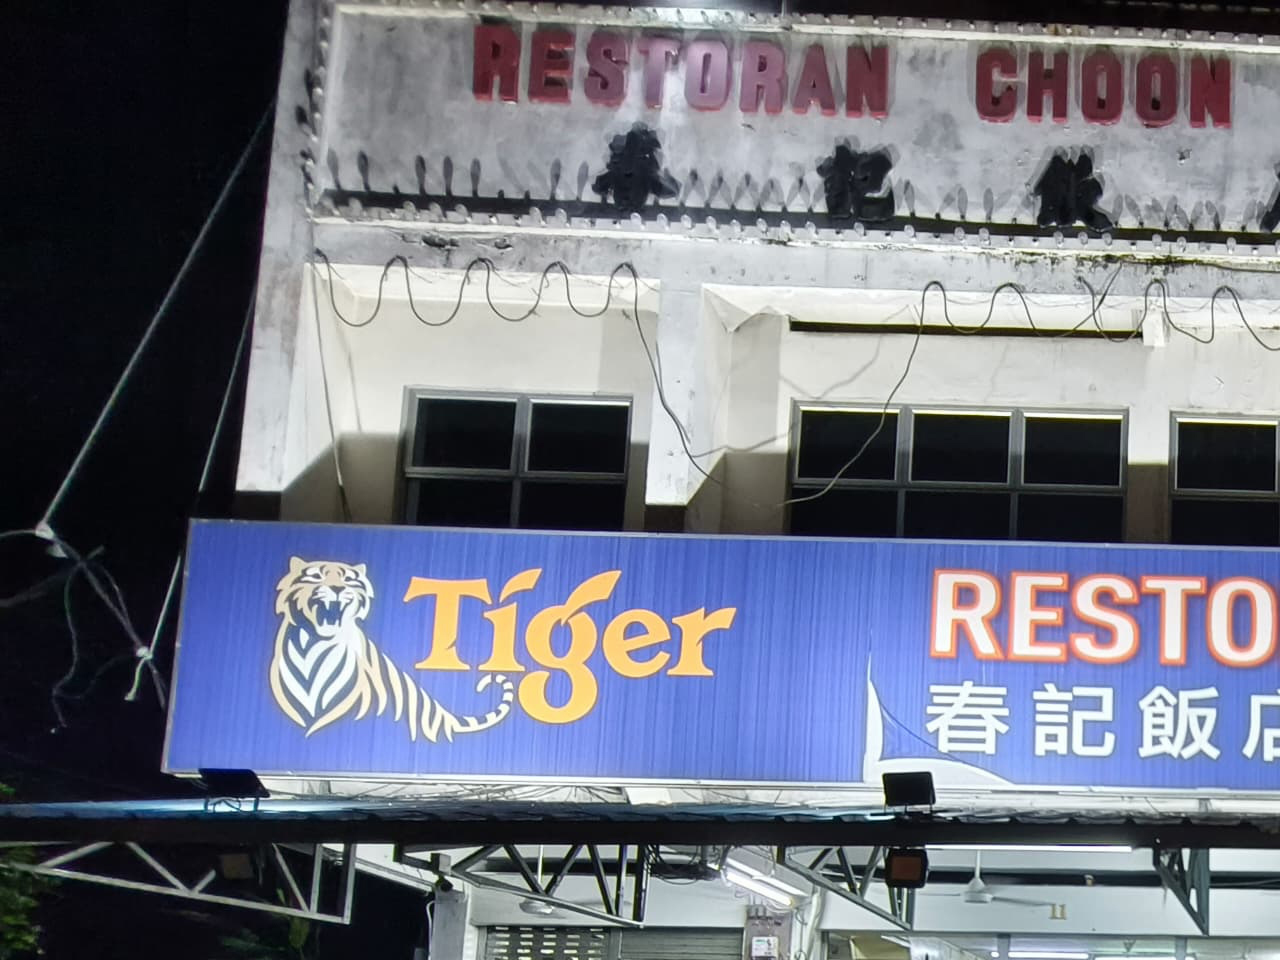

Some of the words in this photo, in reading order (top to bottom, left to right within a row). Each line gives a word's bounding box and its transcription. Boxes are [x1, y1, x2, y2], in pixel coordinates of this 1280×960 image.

[472, 23, 891, 120] RESTORAN
[974, 47, 1233, 129] CHOON
[402, 566, 738, 725] Tiger
